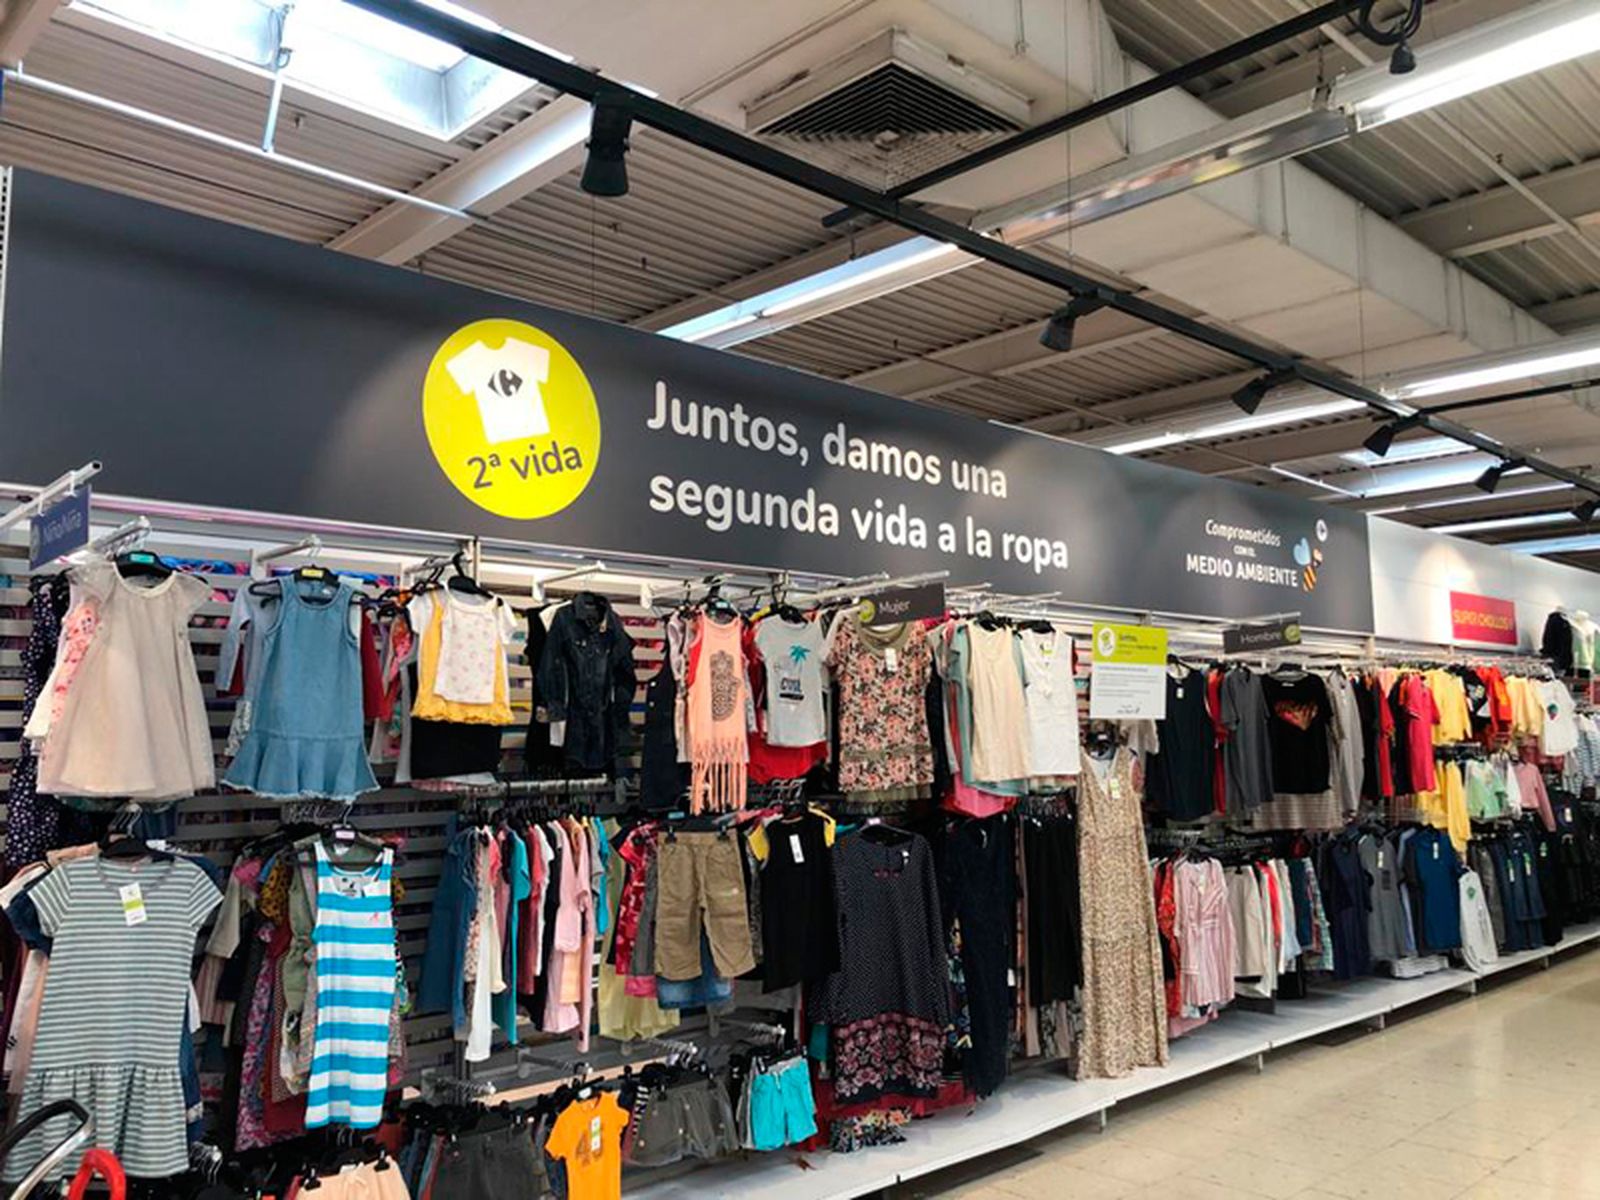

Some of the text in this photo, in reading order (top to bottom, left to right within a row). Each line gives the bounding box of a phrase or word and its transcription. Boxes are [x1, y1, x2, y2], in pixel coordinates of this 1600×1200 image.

[647, 380, 1008, 498] Juntos, damos una
[510, 440, 583, 480] vida
[649, 475, 1069, 574] segunda vida a la ropa
[1205, 519, 1281, 547] Comprometidos
[1186, 553, 1299, 588] MEDIO AMBIENTE
